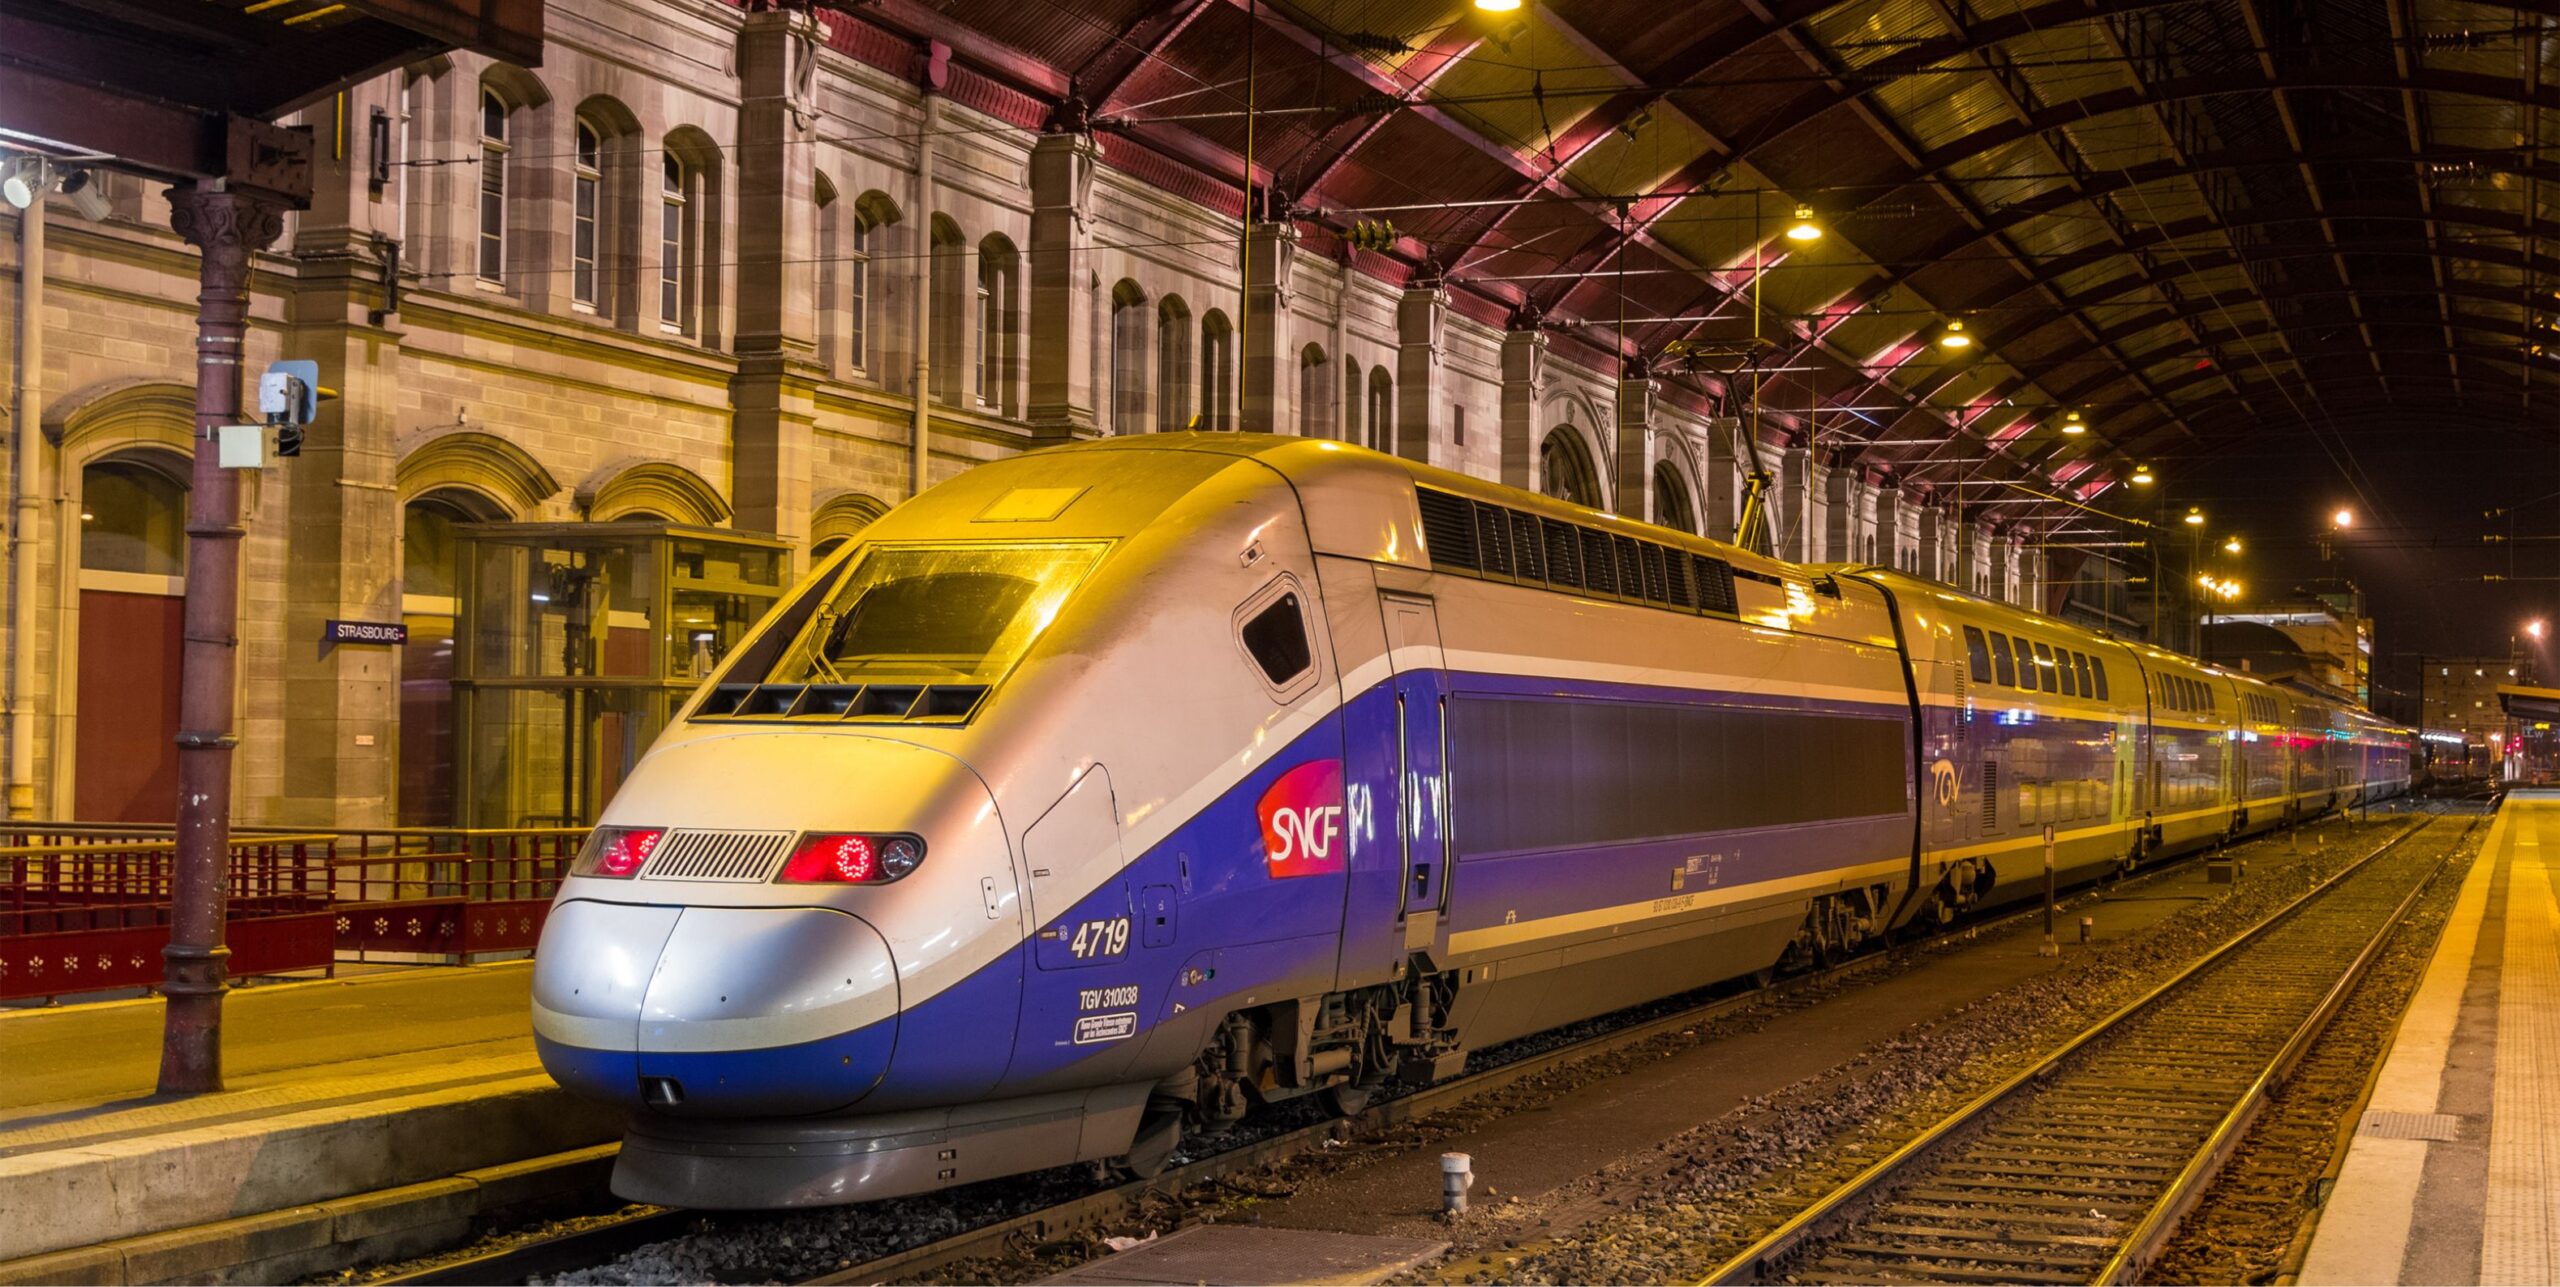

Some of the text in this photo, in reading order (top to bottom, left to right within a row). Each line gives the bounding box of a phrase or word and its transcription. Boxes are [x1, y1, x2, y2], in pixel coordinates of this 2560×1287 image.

[337, 624, 399, 640] STRASBOURG
[1271, 806, 1341, 861] SNCF
[1071, 919, 1128, 958] 4719
[1080, 985, 1138, 1010] TGV 310038
